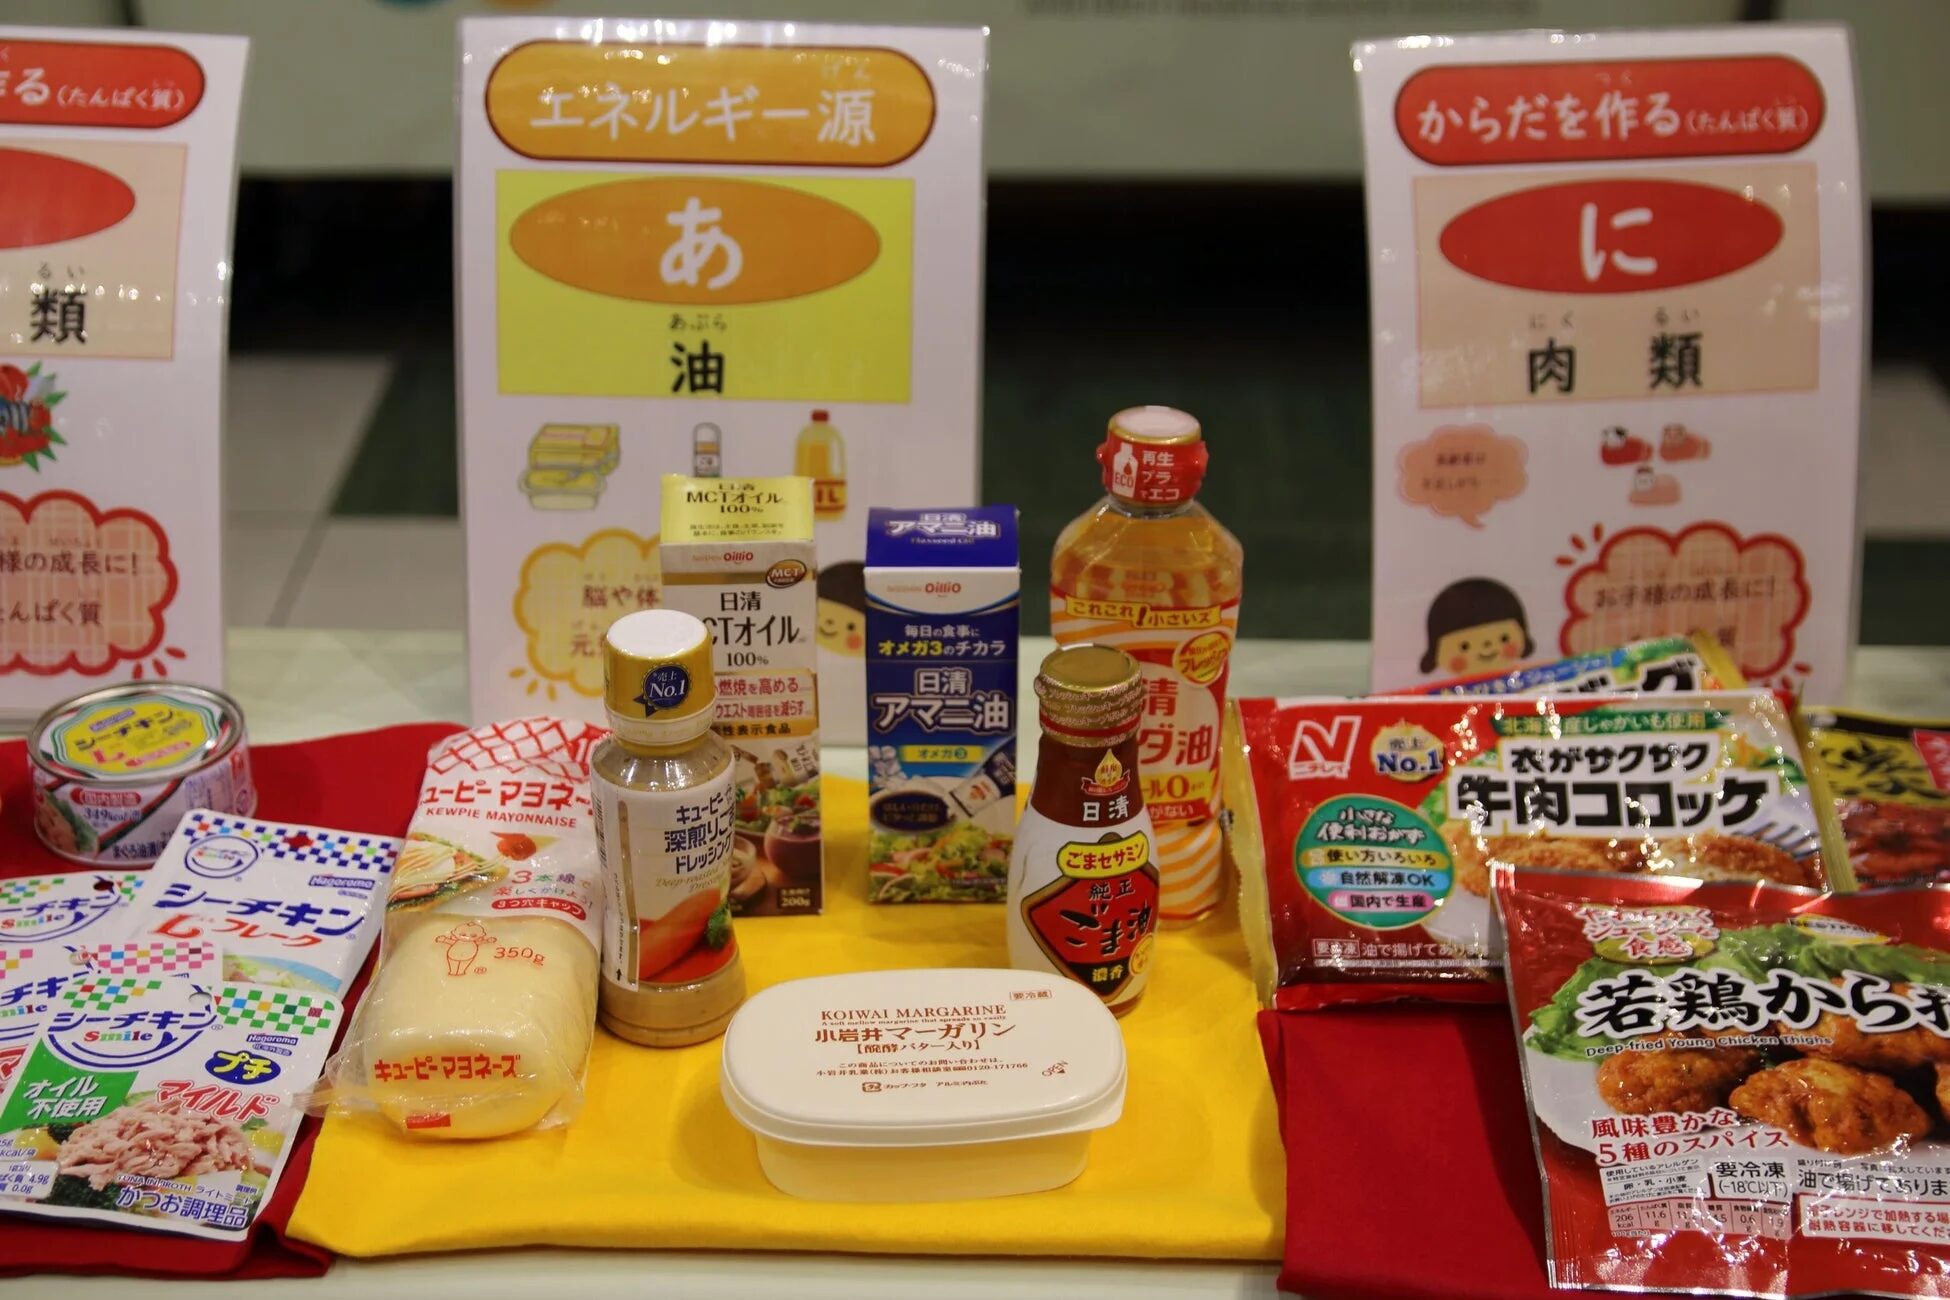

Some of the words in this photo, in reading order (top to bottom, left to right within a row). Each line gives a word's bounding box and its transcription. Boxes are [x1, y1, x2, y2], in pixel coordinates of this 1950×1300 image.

[529, 83, 877, 146] エネルギー源
[660, 196, 743, 289] あ
[1579, 201, 1658, 281] に
[31, 289, 86, 344] 類
[669, 314, 728, 332] あぶら
[1529, 312, 1575, 330] にく
[1655, 306, 1701, 327] るい
[671, 340, 725, 394] 油
[1528, 338, 1577, 394] 肉
[1649, 330, 1704, 390] 類
[1141, 450, 1175, 466] 再生
[1114, 472, 1135, 488] ECO
[1141, 470, 1172, 484] プラ
[686, 491, 784, 503] MCTオイル
[720, 504, 764, 514] 100%
[887, 520, 1000, 536] アマニ油
[770, 567, 800, 577] MCT
[719, 591, 762, 612] 日清
[904, 625, 980, 637] 毎日の食事に
[878, 640, 1007, 656] オメガ3のチカラ
[726, 651, 770, 667] 100%
[657, 670, 677, 682] 売上
[715, 677, 800, 696] 燃焼を高める
[918, 669, 970, 695] 日清
[649, 678, 686, 699] No.1
[873, 694, 1010, 731] アマニ油
[1376, 749, 1442, 773] No.1
[1510, 743, 1710, 774] 衣がサクサク
[1082, 795, 1130, 823] 日清
[1456, 774, 1769, 828] 牛肉コロッケ
[426, 807, 480, 819] KEWPIE
[486, 810, 577, 829] MAYONNAISE
[676, 831, 733, 876] ドレッシング
[1065, 844, 1145, 871] ごまセサミン
[1326, 849, 1438, 867] 使い方いろいろ
[309, 874, 375, 890] Hagoromo
[1088, 879, 1136, 900] 純正
[1341, 871, 1436, 887] 自然解凍OK
[153, 884, 365, 937] シーチキン
[497, 898, 583, 915] 3つ穴キャップ
[1350, 894, 1427, 908] 国内で生産
[211, 918, 324, 948] フレーク
[1059, 900, 1153, 957] ごま油
[494, 946, 546, 967] 350g
[1619, 935, 1694, 958] 食感
[1012, 990, 1050, 1000] 要冷蔵
[47, 1010, 218, 1032] シーチキン
[821, 1009, 889, 1021] KOIWAI
[896, 1004, 1007, 1019] MARGARINE
[939, 1015, 971, 1023] spreads
[83, 1030, 153, 1042] Smile
[247, 1034, 298, 1046] Hagoromo
[815, 1022, 1017, 1043] 小岩井マーガリン
[1586, 1039, 1664, 1057] Deep-fried
[1668, 1036, 1715, 1049] Young
[1718, 1035, 1779, 1047] Chicken
[1782, 1035, 1833, 1047] Thighs
[214, 1051, 273, 1080] プチ
[440, 1053, 521, 1080] マヨネーズ
[1041, 1060, 1069, 1077] OPEN
[23, 1075, 99, 1099] オイル
[27, 1096, 107, 1120] 不使用
[157, 1080, 280, 1121] マイルド
[1590, 1108, 1735, 1141] 風味豊かな
[1598, 1128, 1789, 1165] 5種のスパイス
[1605, 1158, 1699, 1177] 使用しているアレルゲン
[1715, 1161, 1787, 1178] 要冷凍
[117, 1174, 145, 1185] TUNA
[145, 1177, 158, 1186] IN
[159, 1179, 192, 1192] BROTH
[1624, 1175, 1687, 1191] 卵・乳・小麦
[116, 1185, 249, 1228] かつお調理品
[1615, 1214, 1634, 1222] 206
[1645, 1211, 1667, 1219] 11.6
[1617, 1221, 1634, 1229] kcal
